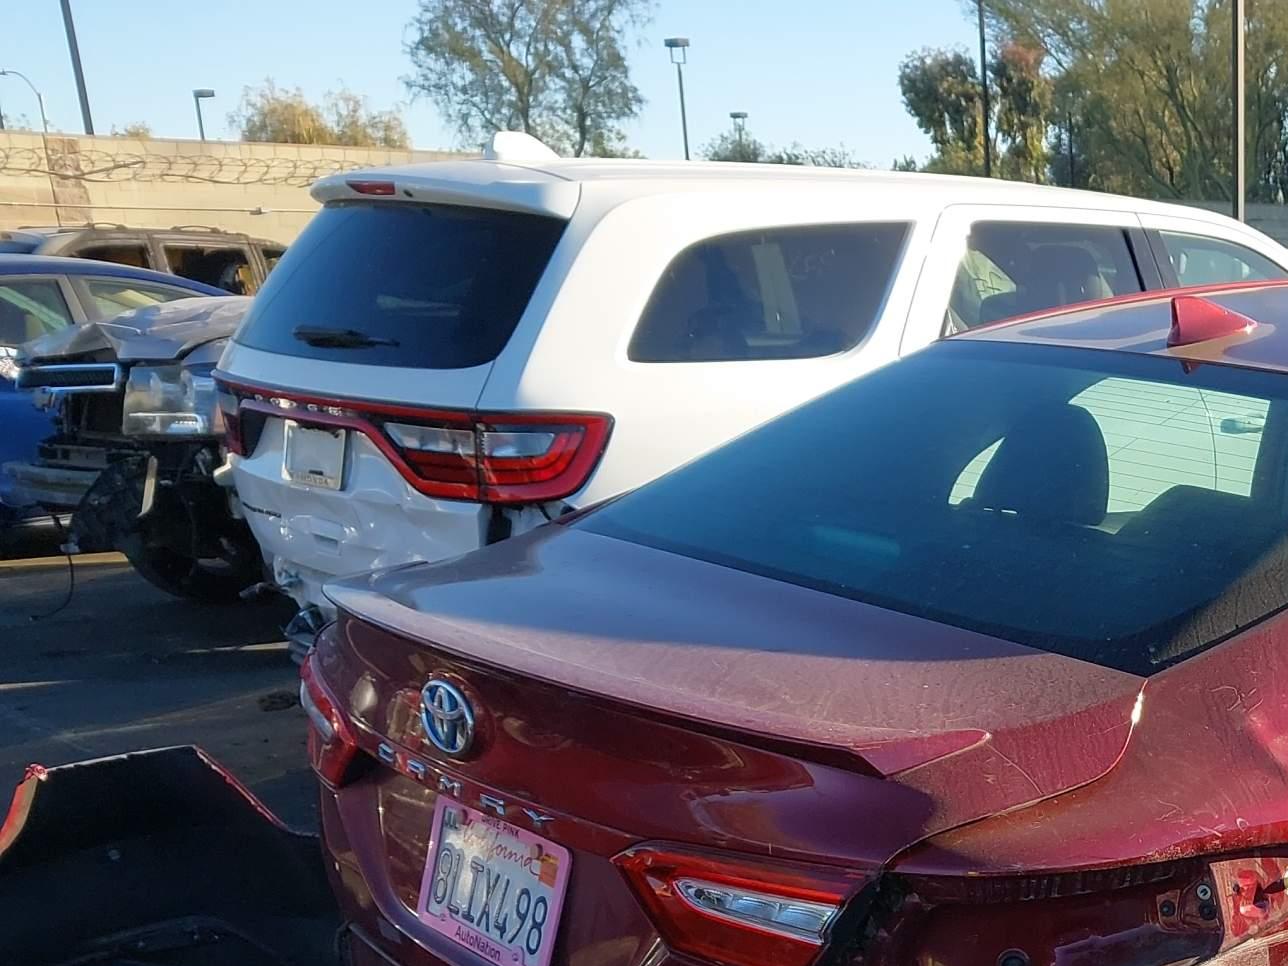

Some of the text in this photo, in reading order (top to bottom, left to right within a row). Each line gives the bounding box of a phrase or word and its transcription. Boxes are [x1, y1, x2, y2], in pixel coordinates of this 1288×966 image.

[377, 742, 556, 828] CAMRY
[502, 822, 520, 840] PINK
[432, 846, 549, 956] 8LIX498
[454, 924, 501, 961] AutoNation
